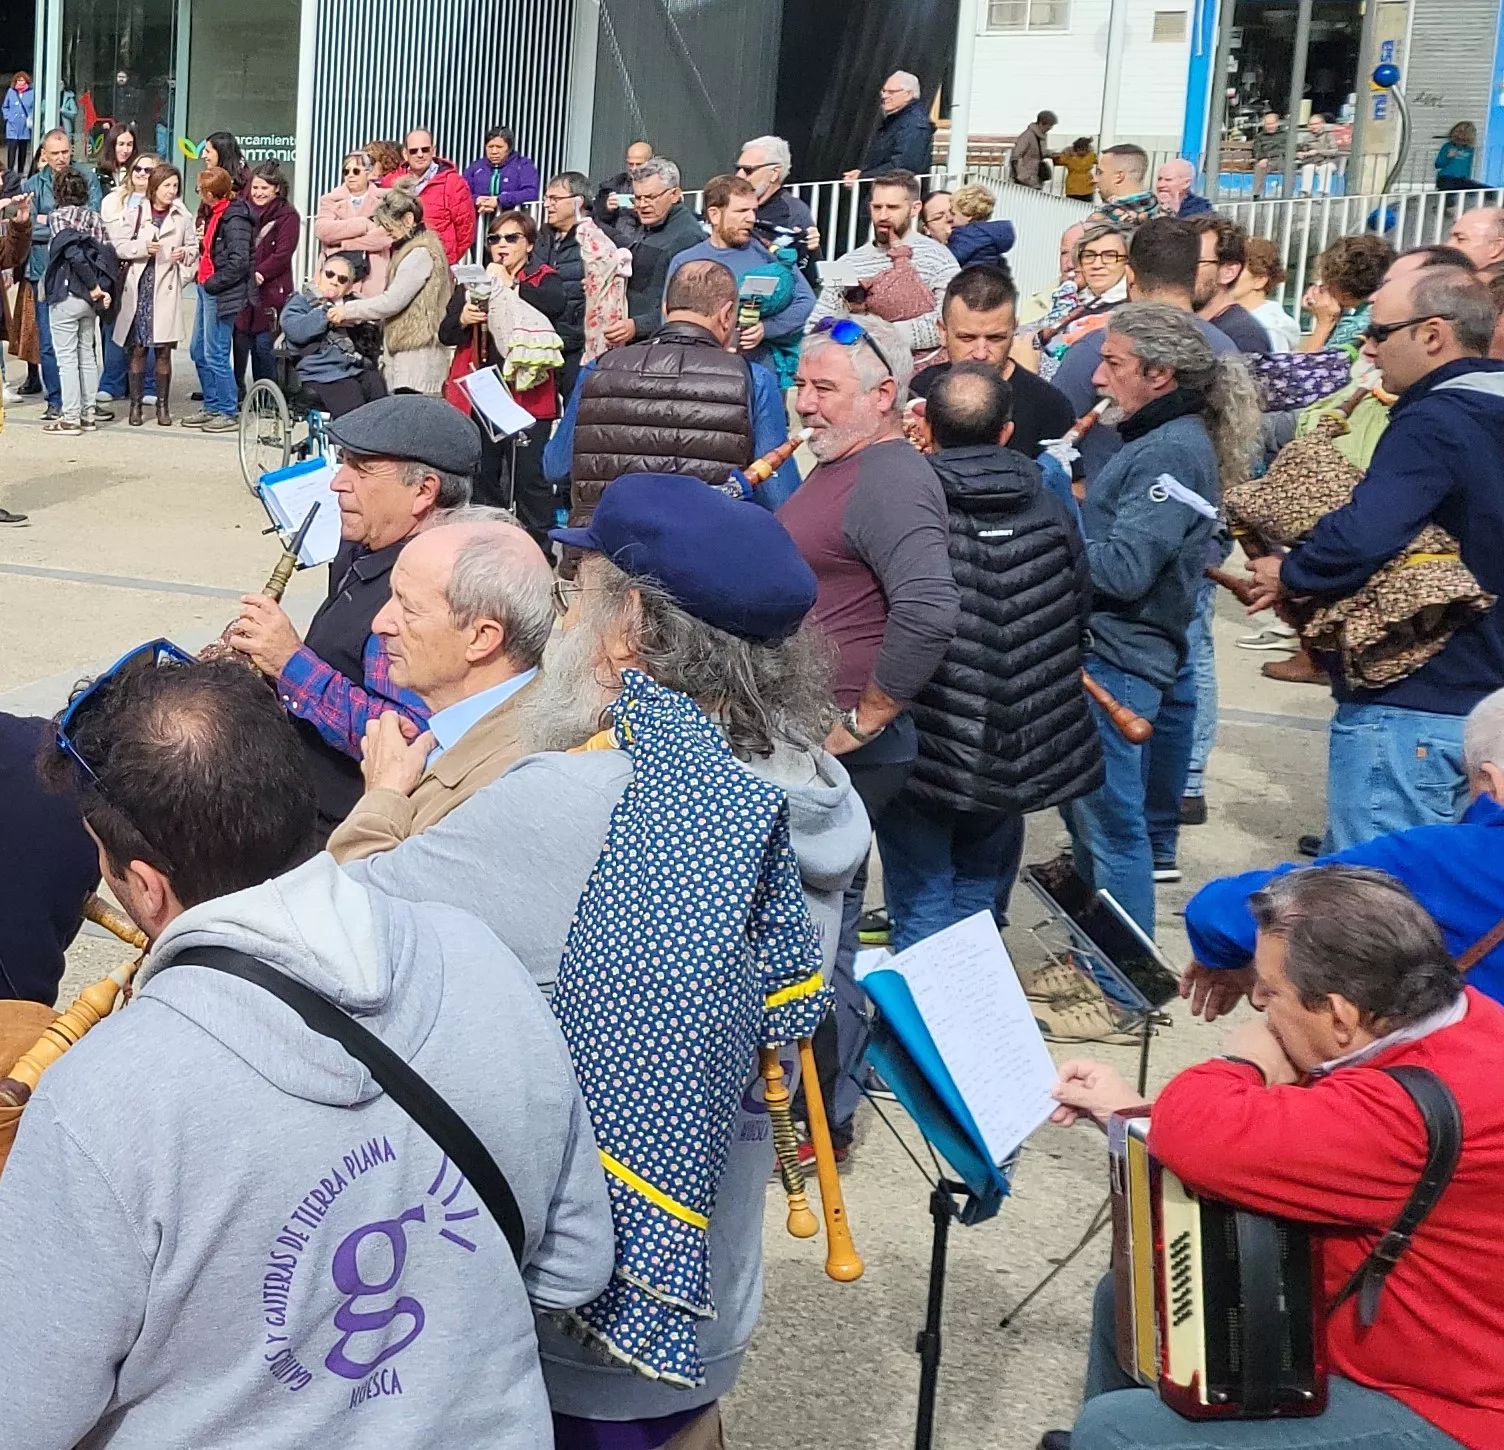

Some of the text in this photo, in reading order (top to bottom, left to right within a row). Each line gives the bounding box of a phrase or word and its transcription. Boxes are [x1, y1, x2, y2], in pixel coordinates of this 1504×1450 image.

[343, 1136, 396, 1180] PLANA
[290, 1168, 348, 1229] TIERRA
[276, 1225, 311, 1252] DE
[263, 1250, 297, 1326] GAITERAS
[266, 1333, 288, 1345] Y
[349, 1367, 403, 1410] HUESCA
